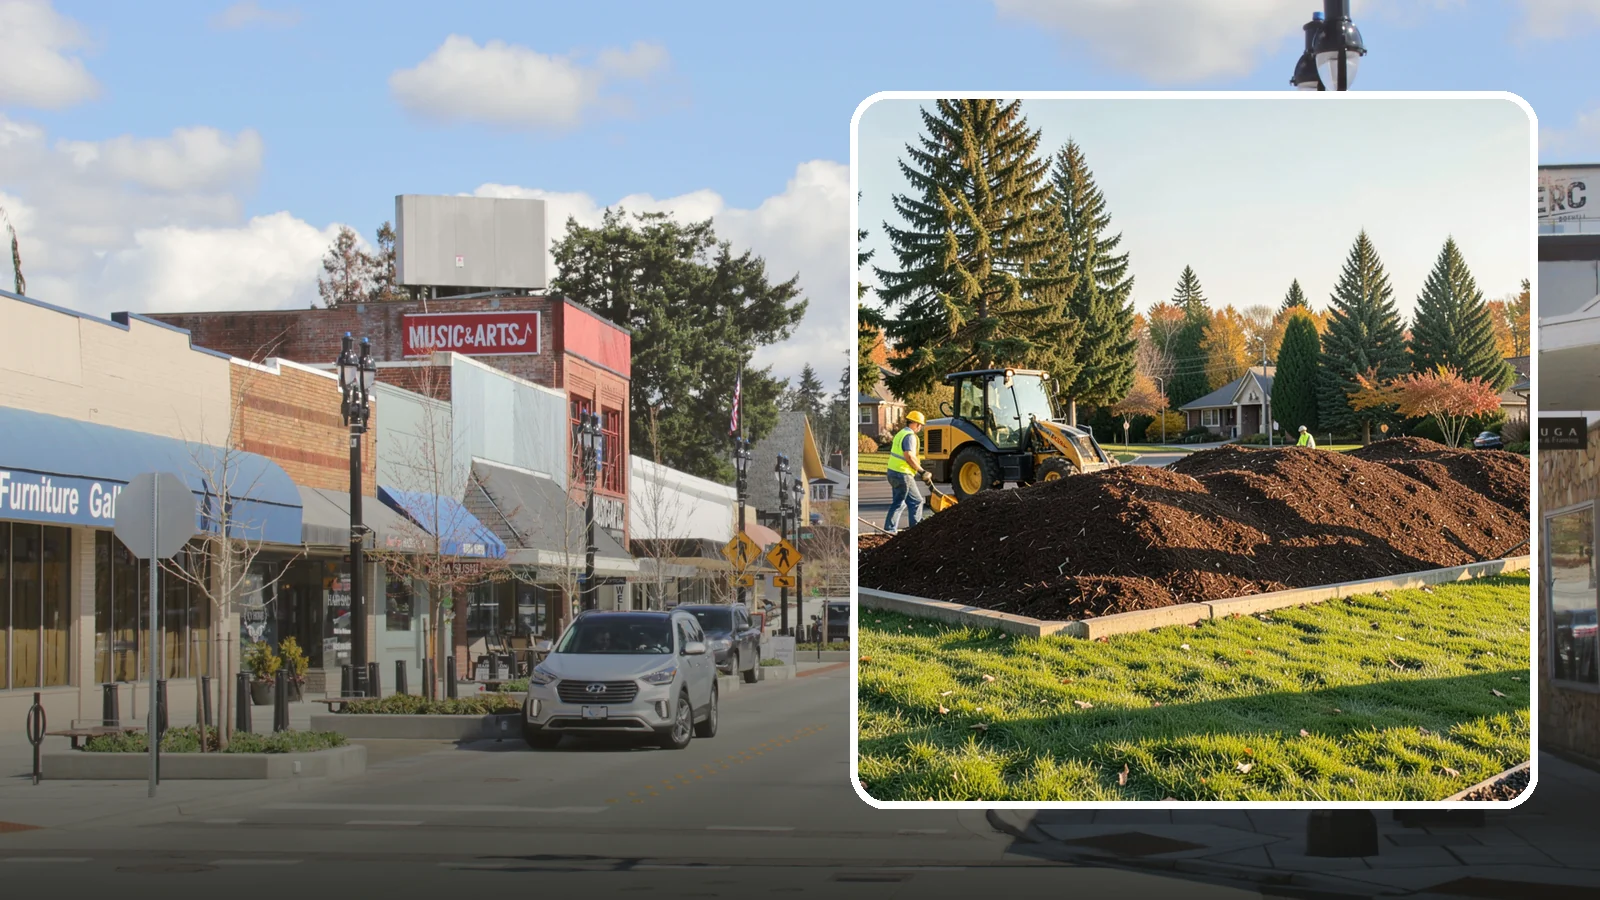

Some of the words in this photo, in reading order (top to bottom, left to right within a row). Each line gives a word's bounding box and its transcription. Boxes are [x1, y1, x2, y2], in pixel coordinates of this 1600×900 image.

[408, 323, 520, 349] MUSIC&ARTS
[0, 471, 79, 515] Furniture
[89, 482, 122, 519] Gal
